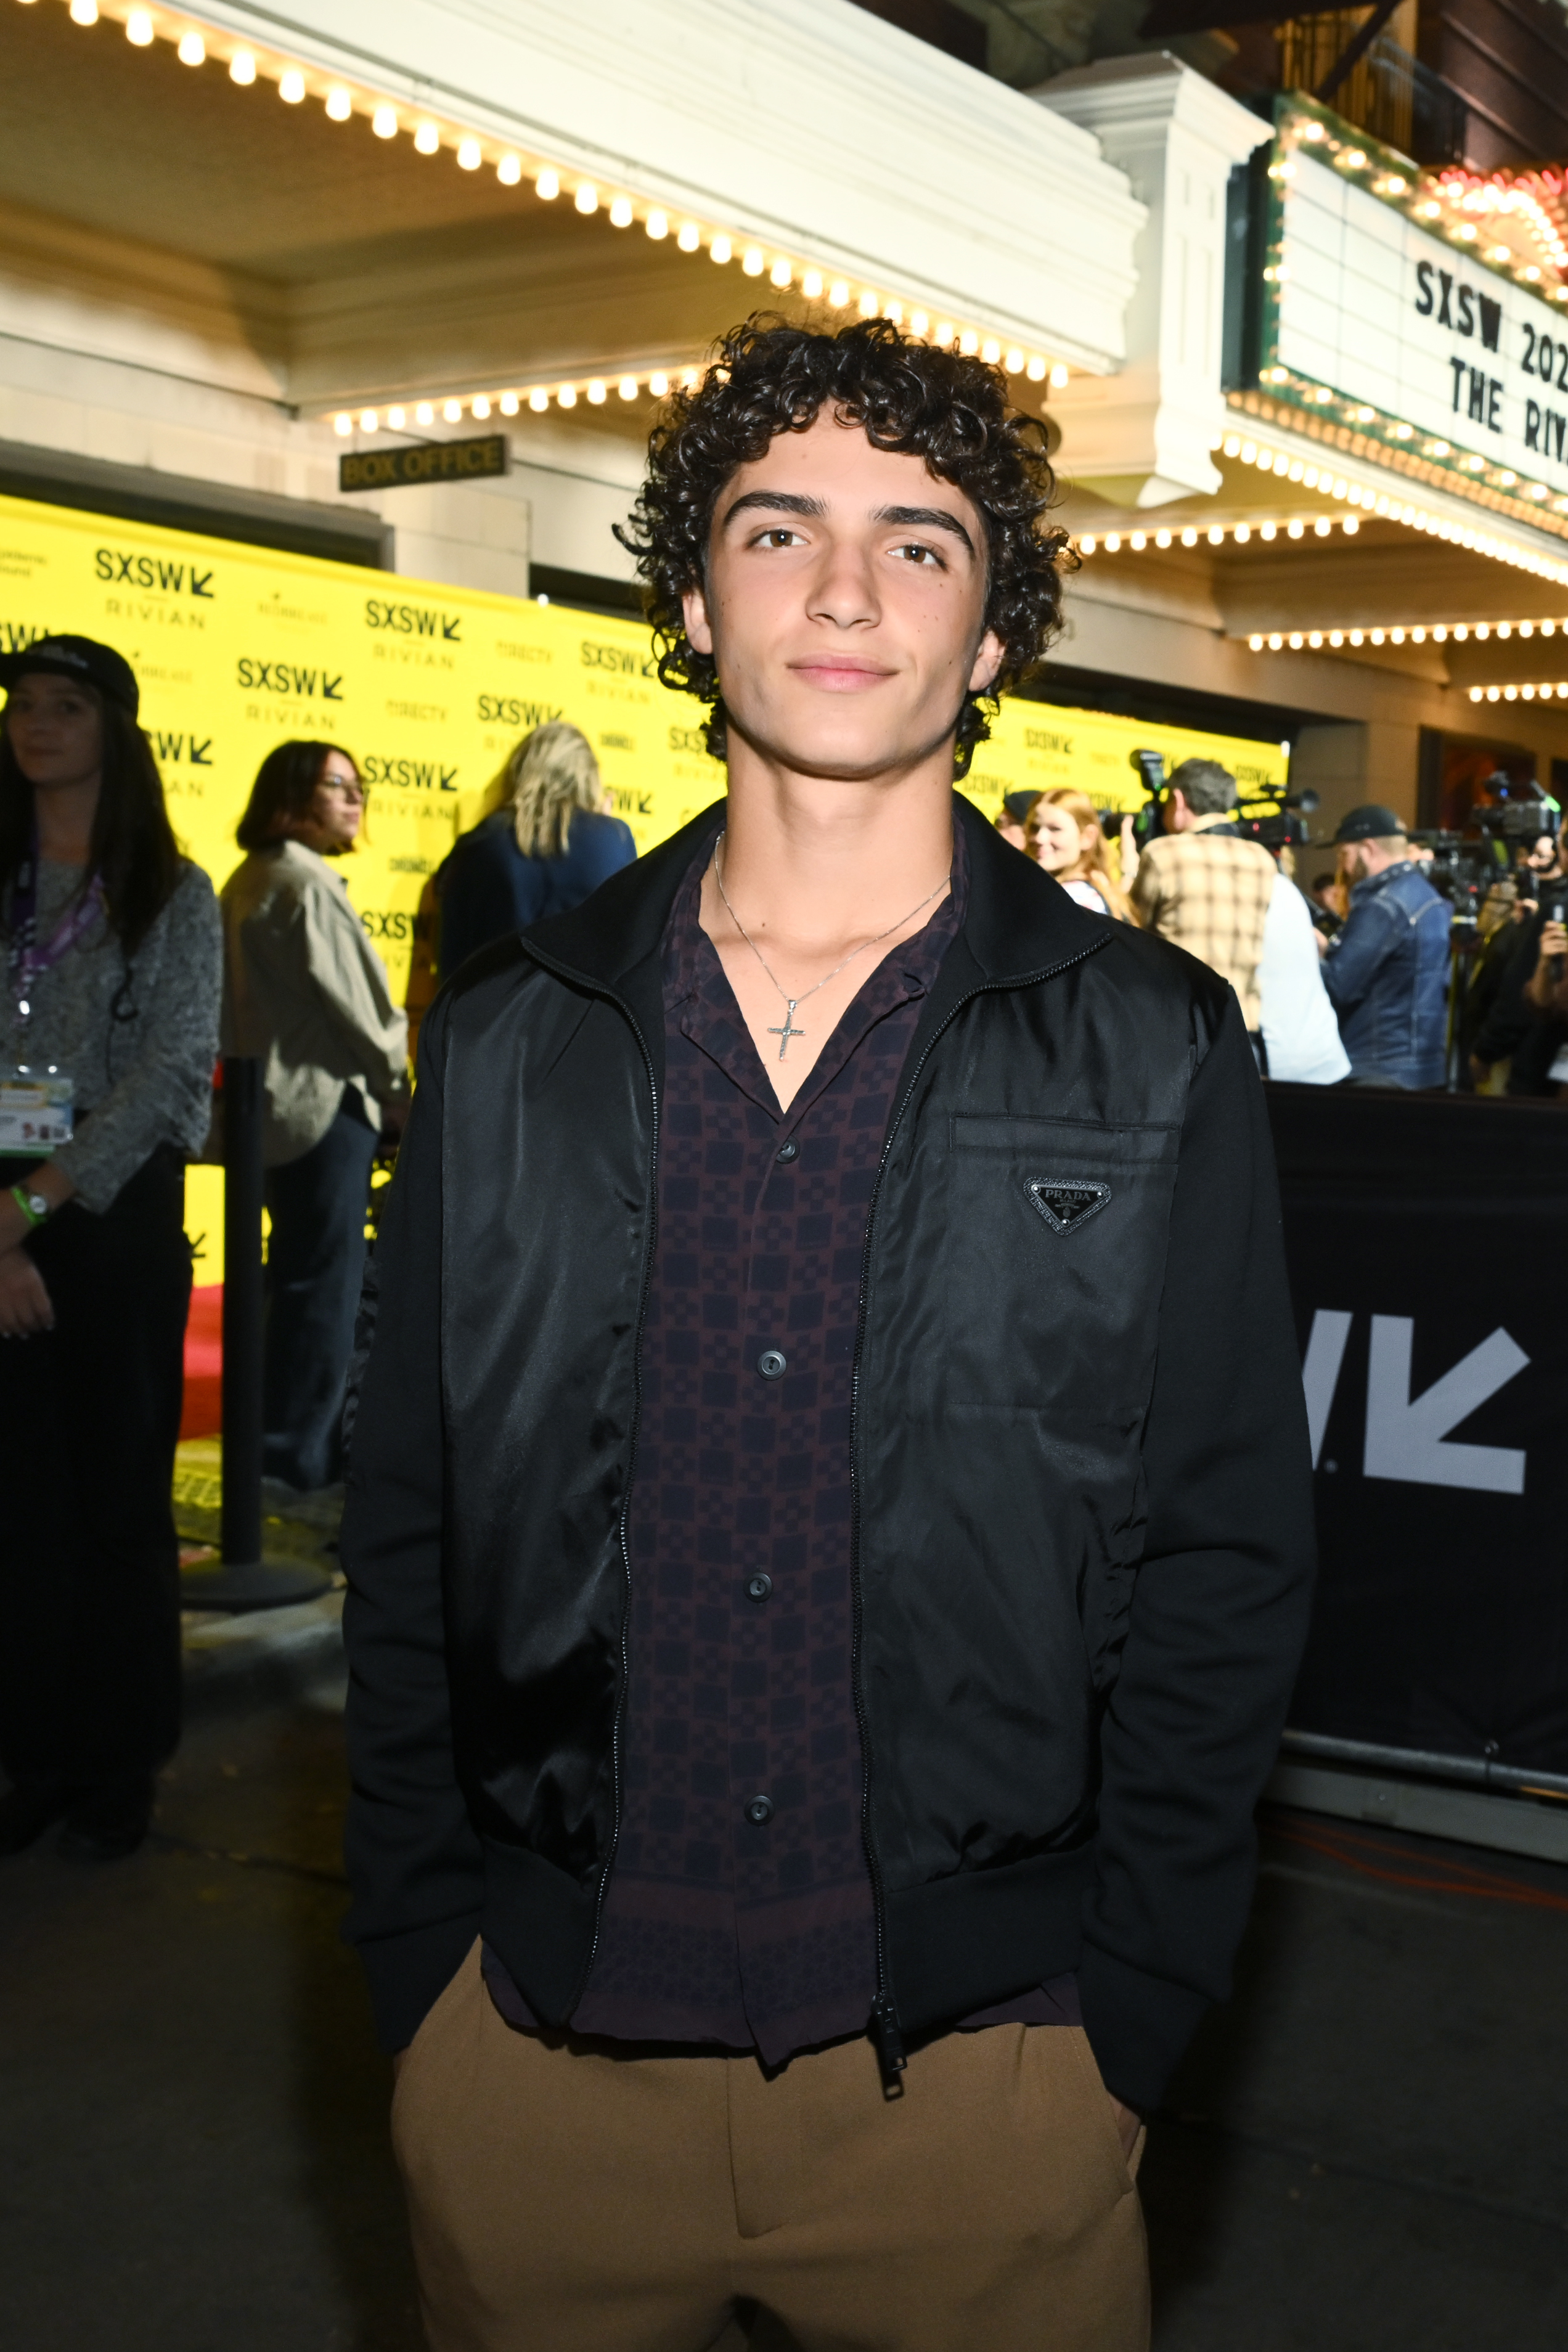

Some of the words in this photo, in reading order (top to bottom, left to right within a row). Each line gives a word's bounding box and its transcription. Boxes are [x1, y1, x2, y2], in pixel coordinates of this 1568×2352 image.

[1415, 260, 1501, 353] SXSW
[1450, 356, 1503, 434] THE
[1525, 398, 1568, 463] RIV
[343, 455, 397, 484] BOX
[404, 441, 501, 478] OFFICE
[96, 549, 184, 593] SXSW
[105, 598, 206, 630] RIVIAN
[365, 599, 436, 636] SXSW
[374, 644, 454, 669] RIVIAN
[581, 642, 635, 673] SXSW
[238, 658, 316, 696] SXSW
[247, 704, 335, 729] RIVIAN
[478, 695, 543, 725] SXSW
[669, 727, 705, 753] SXS
[365, 756, 434, 788] SXSW
[374, 800, 452, 819] RIVIAN
[1045, 1189, 1091, 1201] PRADA
